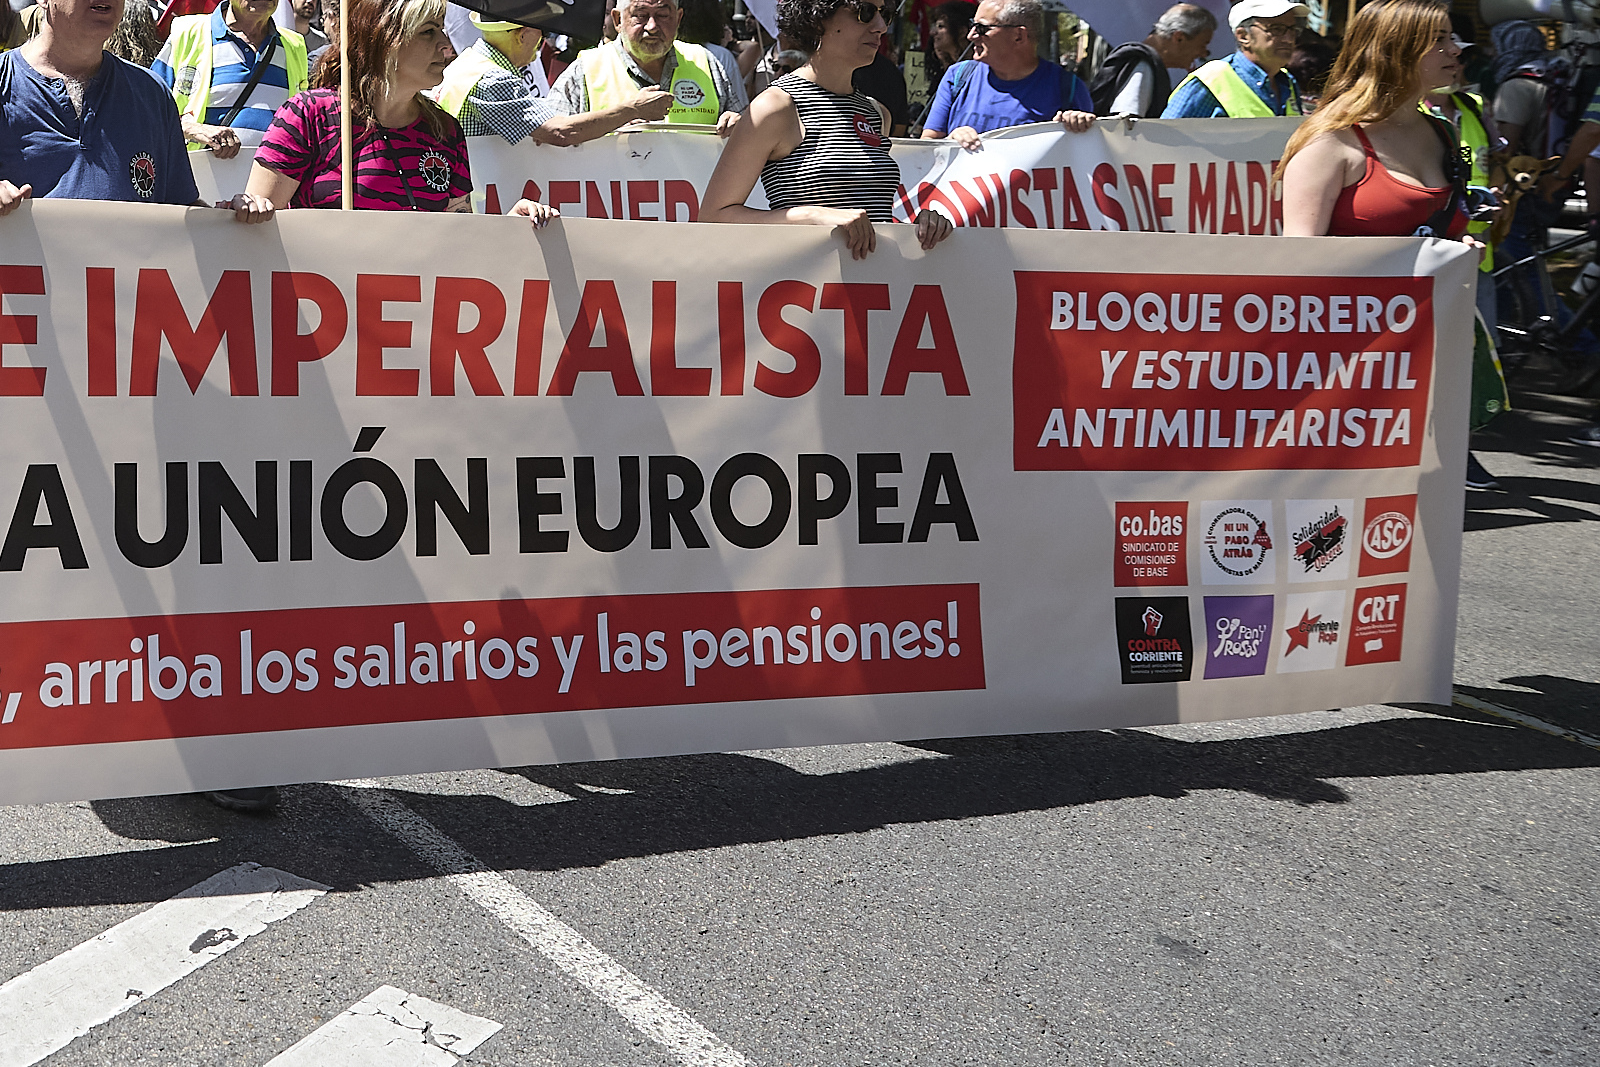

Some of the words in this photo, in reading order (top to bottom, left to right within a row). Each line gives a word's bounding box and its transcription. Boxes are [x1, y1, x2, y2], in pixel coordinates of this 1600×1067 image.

[690, 107, 716, 115] UNIDAD
[1127, 163, 1176, 234] DE
[1050, 291, 1223, 334] BLOQUE
[1234, 294, 1417, 334] OBRERO
[85, 267, 971, 398] IMPERIALISTA
[1100, 350, 1128, 389] Y
[1131, 350, 1417, 391] ESTUDIANTIL
[1037, 408, 1411, 448] ANTIMILITARISTA
[114, 426, 490, 569] UNIÓN
[517, 451, 980, 554] EUROPEA
[1119, 509, 1183, 537] co.bas
[1224, 523, 1234, 532] NI
[1236, 523, 1249, 532] UN
[1292, 504, 1339, 546] Solidaridad
[1370, 519, 1405, 550] ASC
[1122, 542, 1167, 553] SINDICATO
[1168, 542, 1179, 552] DE
[1224, 536, 1250, 545] PASO
[1124, 555, 1177, 565] COMISIONES
[1133, 567, 1145, 577] DE
[1146, 567, 1168, 577] BASE
[1357, 594, 1400, 624] CRT
[1299, 619, 1340, 633] Corriente
[1318, 631, 1338, 645] Roja
[40, 633, 223, 709] arriba
[240, 629, 319, 696] los
[333, 620, 540, 689] salarios
[550, 634, 584, 695] y
[597, 612, 667, 675] las
[683, 600, 961, 687] pensiones!
[1127, 638, 1182, 652] CONTRA
[1128, 651, 1183, 662] CORRIENTE
